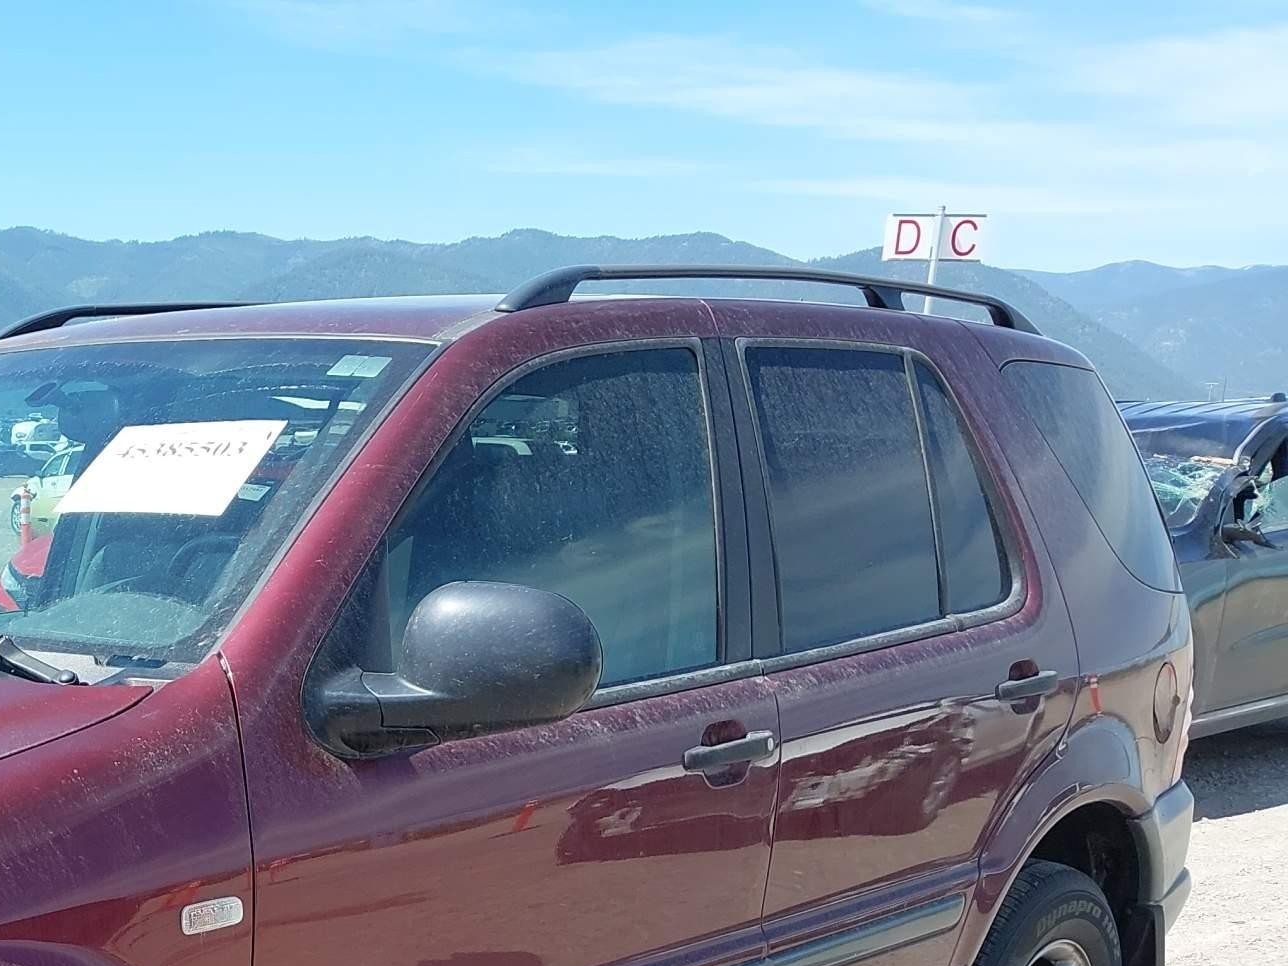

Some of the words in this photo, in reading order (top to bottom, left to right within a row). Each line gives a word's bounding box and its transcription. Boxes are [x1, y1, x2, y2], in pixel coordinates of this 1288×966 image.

[894, 219, 922, 256] D
[951, 219, 978, 257] C
[115, 441, 249, 459] 45385503
[1035, 899, 1103, 938] Dynapro
